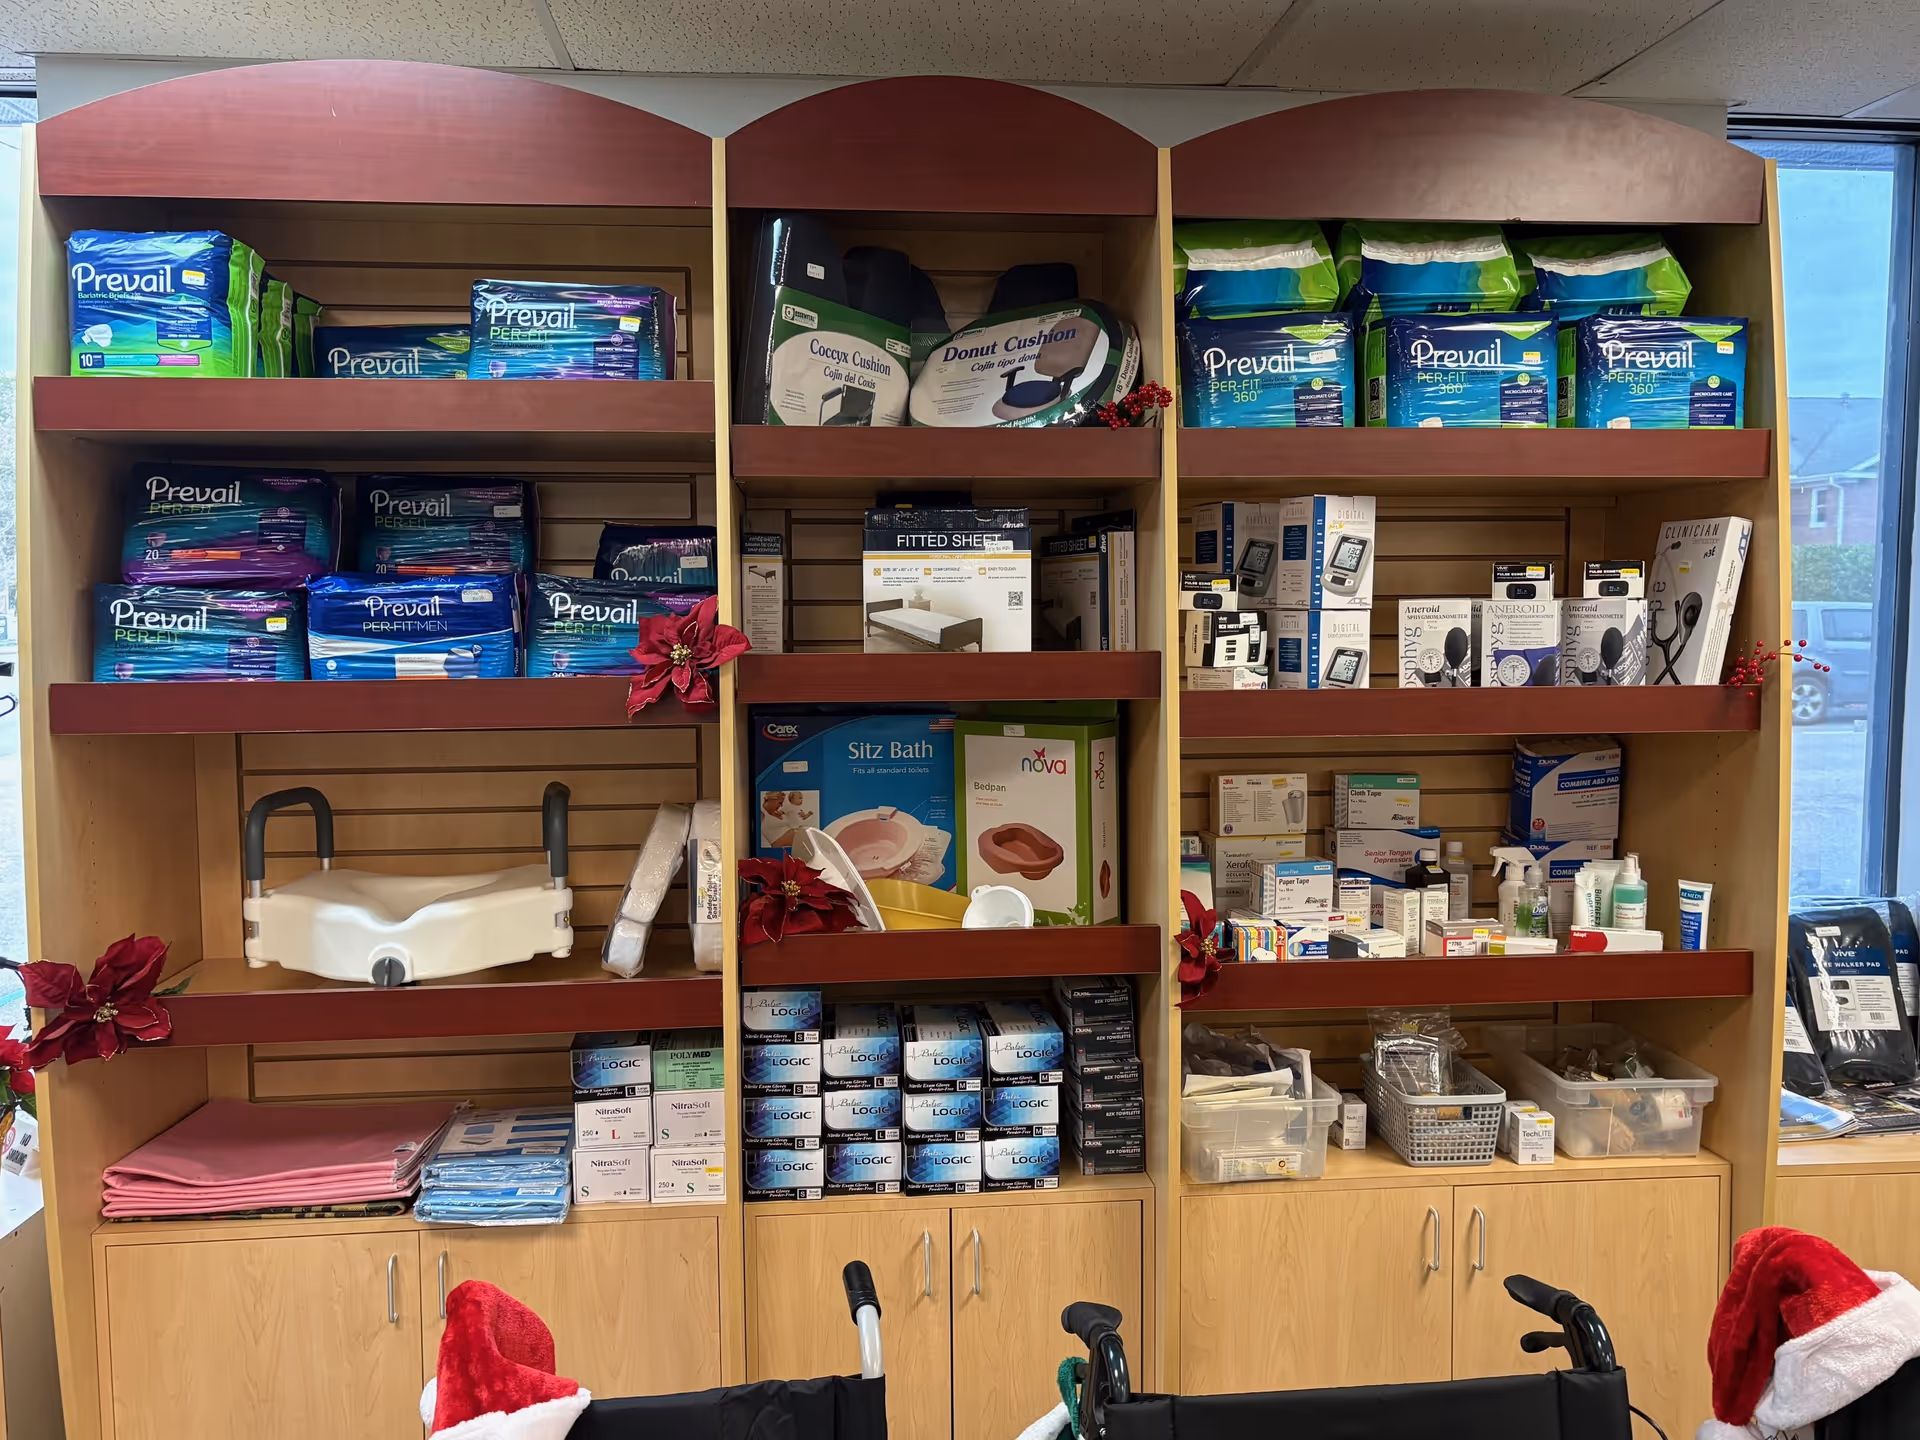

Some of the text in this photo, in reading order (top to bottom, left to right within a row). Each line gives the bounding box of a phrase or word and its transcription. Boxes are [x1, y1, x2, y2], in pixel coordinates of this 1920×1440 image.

[943, 328, 1077, 363] Donut Cushion
[81, 355, 92, 366] 10
[810, 338, 891, 376] Coccyx Cushion
[997, 357, 1015, 369] tipo
[1018, 352, 1041, 363] dona
[1120, 357, 1131, 379] Donut
[845, 372, 855, 384] del
[858, 376, 876, 389] Coxis
[1417, 371, 1467, 384] PER-FIT
[1608, 372, 1657, 383] PER-FIT
[1211, 379, 1260, 392] PER-FIT
[1337, 510, 1365, 520] DIGITAL
[1665, 523, 1720, 539] CLINICIAN
[897, 534, 947, 547] FITTED
[1069, 539, 1087, 551] SHEET
[145, 550, 159, 560] 20
[376, 564, 387, 574] 20
[1405, 605, 1440, 613] Aneroid
[1487, 604, 1546, 614] ANEROID
[1567, 604, 1598, 612] Aneroid
[417, 621, 448, 631] MEN
[553, 621, 614, 636] PER-FIT
[1333, 623, 1360, 633] DIGITAL
[115, 629, 179, 644] PER-FIT
[767, 723, 798, 735] Carex
[848, 740, 933, 759] Sitz Bath
[1022, 757, 1067, 774] nova
[974, 782, 1007, 792] Bedpan
[1533, 904, 1548, 913] Dial
[670, 1051, 711, 1059] POLYMED
[851, 1054, 889, 1062] LOGIC
[602, 1059, 641, 1070] LOGIC
[772, 1058, 810, 1066] LOGIC
[934, 1057, 972, 1065] LOGIC
[595, 1106, 631, 1115] NitraSoft
[671, 1101, 711, 1110] NitraSoft
[852, 1107, 890, 1115] LOGIC
[612, 1129, 620, 1139] L
[661, 1129, 670, 1139] S
[1522, 1130, 1552, 1138] TechLITE
[20, 1133, 32, 1147] NO
[591, 1158, 631, 1167] NitraSoft
[672, 1159, 707, 1167] NitraSoft
[855, 1156, 893, 1165] LOGIC
[776, 1163, 814, 1171] LOGIC
[581, 1186, 589, 1196] S
[687, 1183, 694, 1193] S
